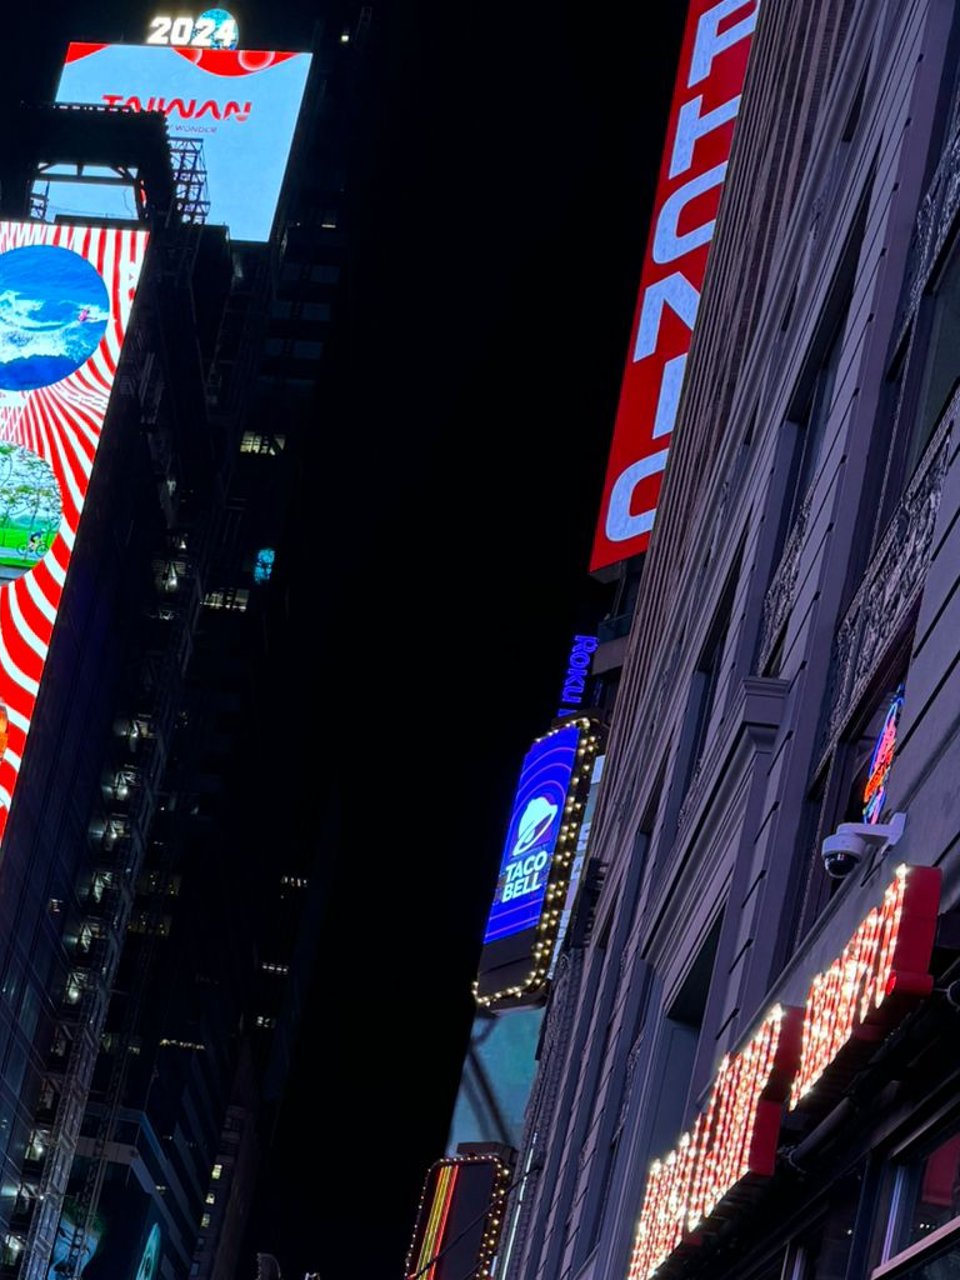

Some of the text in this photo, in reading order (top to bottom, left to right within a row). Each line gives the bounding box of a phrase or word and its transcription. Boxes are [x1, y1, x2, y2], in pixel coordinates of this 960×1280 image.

[146, 16, 236, 48] 2024
[102, 94, 253, 121] TAIWAN
[504, 850, 548, 883] TACO
[501, 872, 543, 903] BELL
